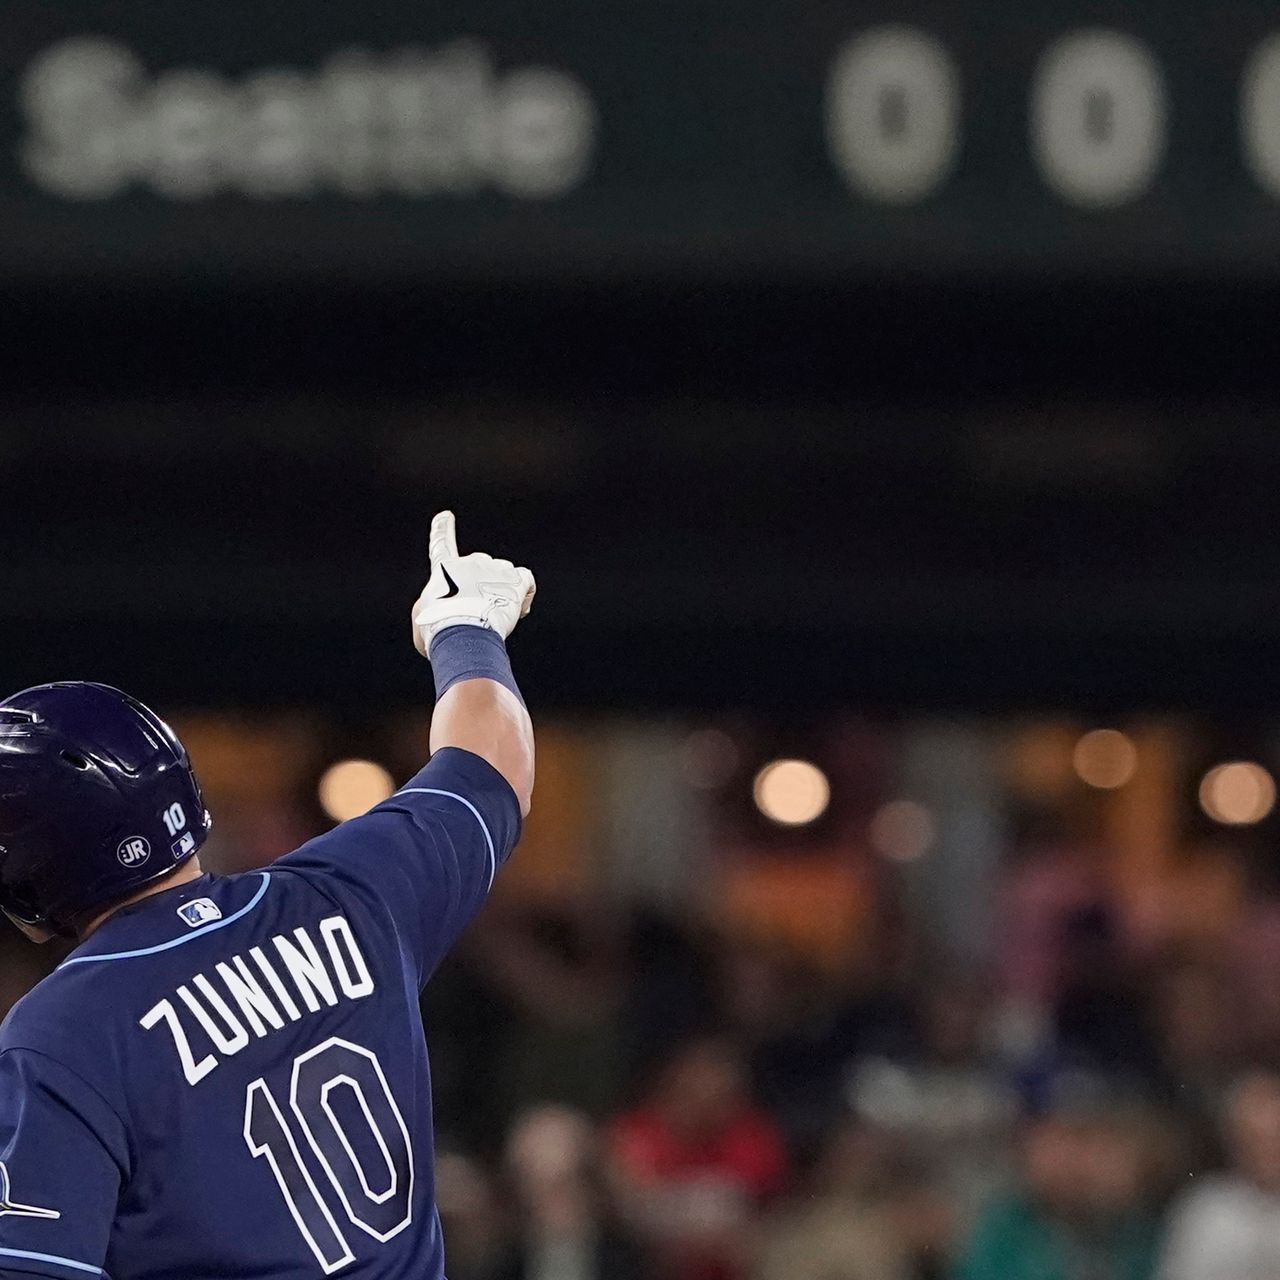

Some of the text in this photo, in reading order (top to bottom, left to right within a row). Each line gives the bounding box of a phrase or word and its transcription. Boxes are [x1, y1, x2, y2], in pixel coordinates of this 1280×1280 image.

[21, 38, 593, 198] Seattle
[827, 26, 959, 203] 0
[1031, 29, 1166, 206] 0
[162, 801, 187, 837] 10
[139, 915, 376, 1087] ZUNINO
[243, 1036, 415, 1275] 10
